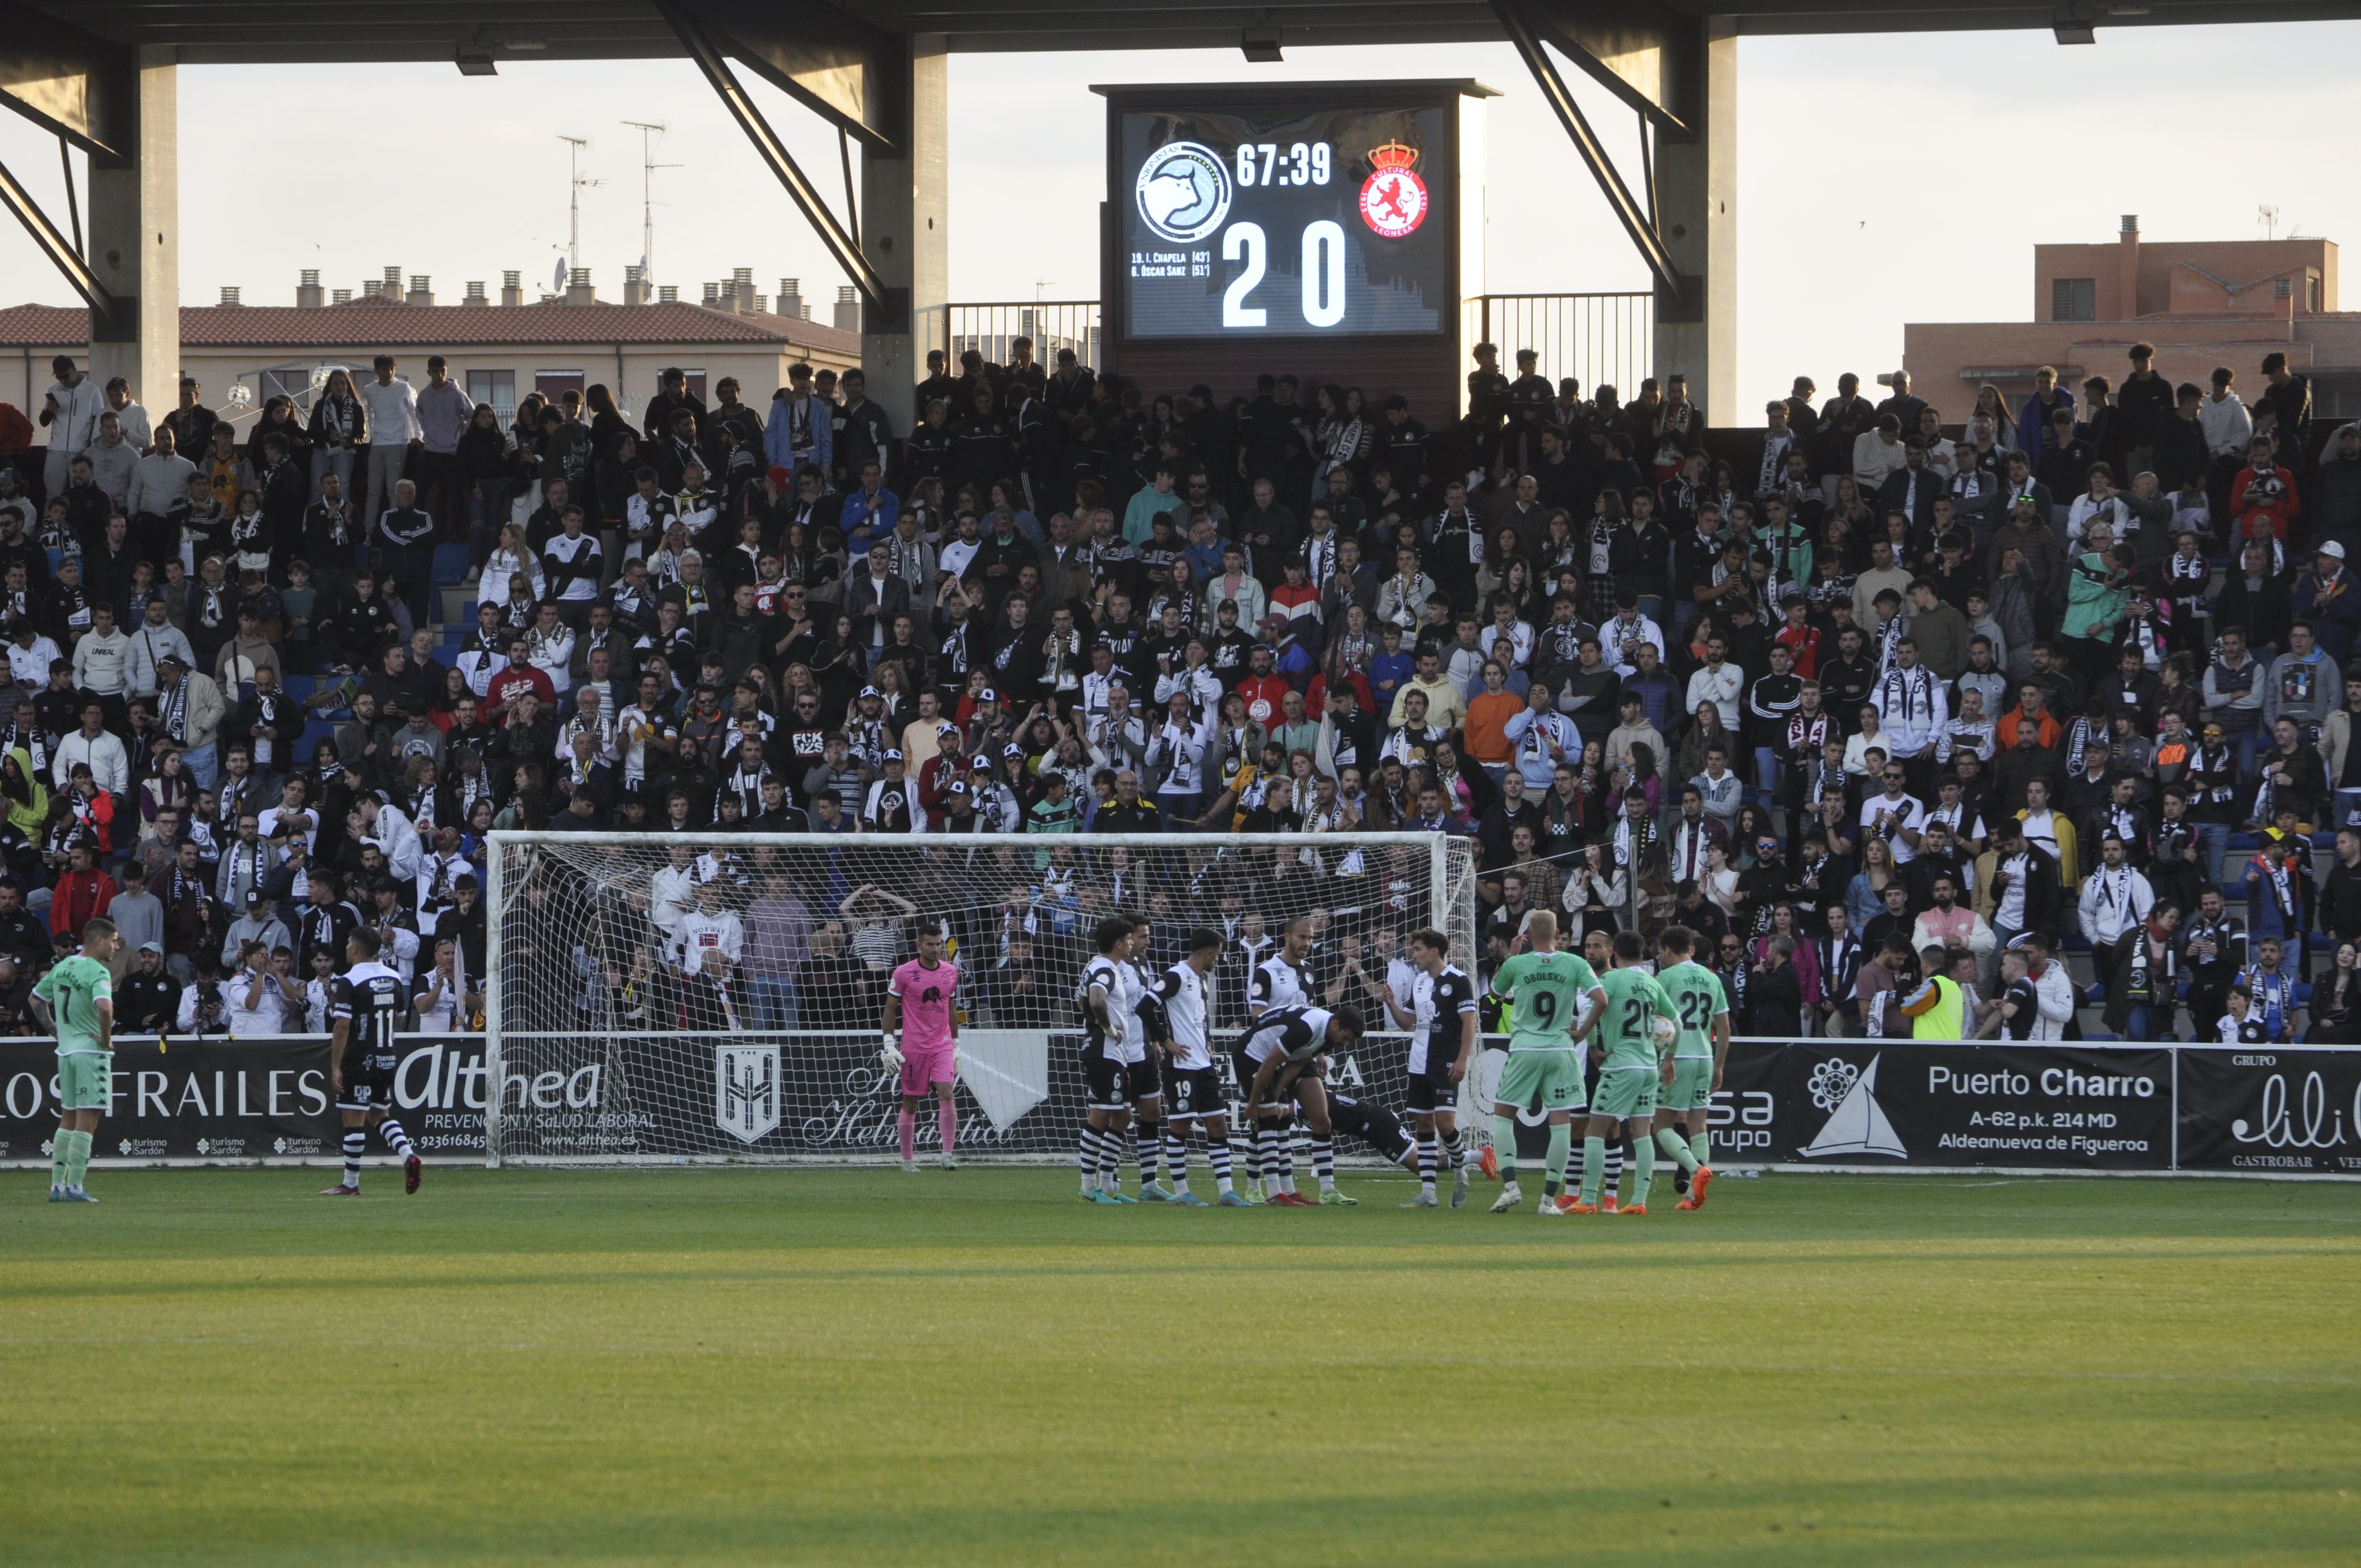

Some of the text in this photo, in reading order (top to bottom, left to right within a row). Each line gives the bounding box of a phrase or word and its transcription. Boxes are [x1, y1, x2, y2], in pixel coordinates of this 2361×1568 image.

[1237, 142, 1330, 187] 67:39
[1372, 166, 1414, 181] CULTURAL
[1374, 225, 1413, 236] LEONESA
[1131, 252, 1144, 263] 19.
[1222, 220, 1346, 327] 2 0
[91, 647, 115, 656] UNREAL
[792, 731, 824, 746] FCK
[692, 927, 727, 935] NORWAY
[1524, 972, 1566, 984] OBOLSKII
[58, 984, 72, 1025] 7
[1532, 991, 1556, 1031] 9
[1680, 990, 1713, 1031] 23
[374, 1009, 394, 1047] 11
[2232, 1055, 2277, 1066] GRUPO
[1113, 1075, 1121, 1090] 6
[1175, 1080, 1192, 1097] 19
[1929, 1066, 2155, 1097] Puerto Charro
[105, 1070, 327, 1117] FRAILES
[587, 1113, 657, 1129] LABORAL
[802, 1100, 1016, 1145] Helmático
[1969, 1111, 2117, 1130] A-62 p.k. 214 MD
[134, 1138, 167, 1146] turismo
[212, 1137, 245, 1146] turismo
[289, 1137, 322, 1146] turismo
[541, 1133, 635, 1147] www.althea.es
[1709, 1130, 1772, 1153] rupo
[1938, 1133, 2148, 1156] Aldeanueva de Figueroa
[134, 1146, 165, 1155] Sardón
[212, 1146, 242, 1155] Sardón
[289, 1145, 319, 1154] Sardón
[2232, 1155, 2314, 1168] GASTROBAR
